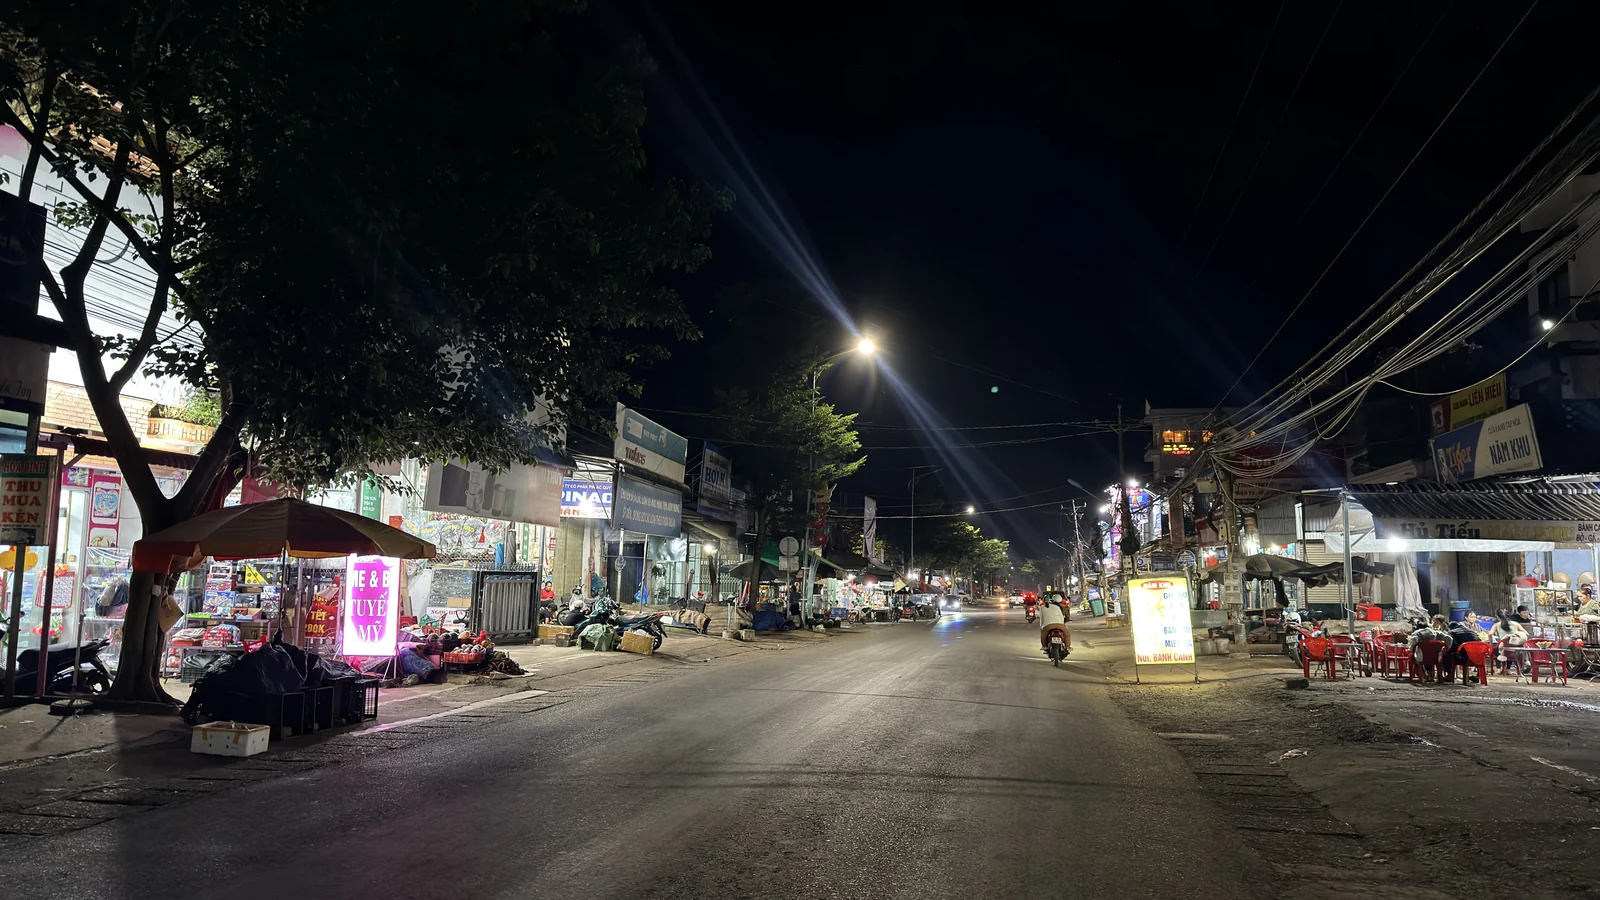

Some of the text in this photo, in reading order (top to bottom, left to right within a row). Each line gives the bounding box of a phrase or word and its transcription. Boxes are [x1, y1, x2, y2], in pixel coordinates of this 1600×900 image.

[1445, 441, 1473, 476] Tiger
[1489, 435, 1531, 466] NĂM KHU
[5, 480, 42, 492] THU
[2, 495, 41, 506] MUA
[1435, 521, 1480, 539] Tiếu
[369, 570, 379, 588] &
[351, 591, 390, 617] TUYẾ
